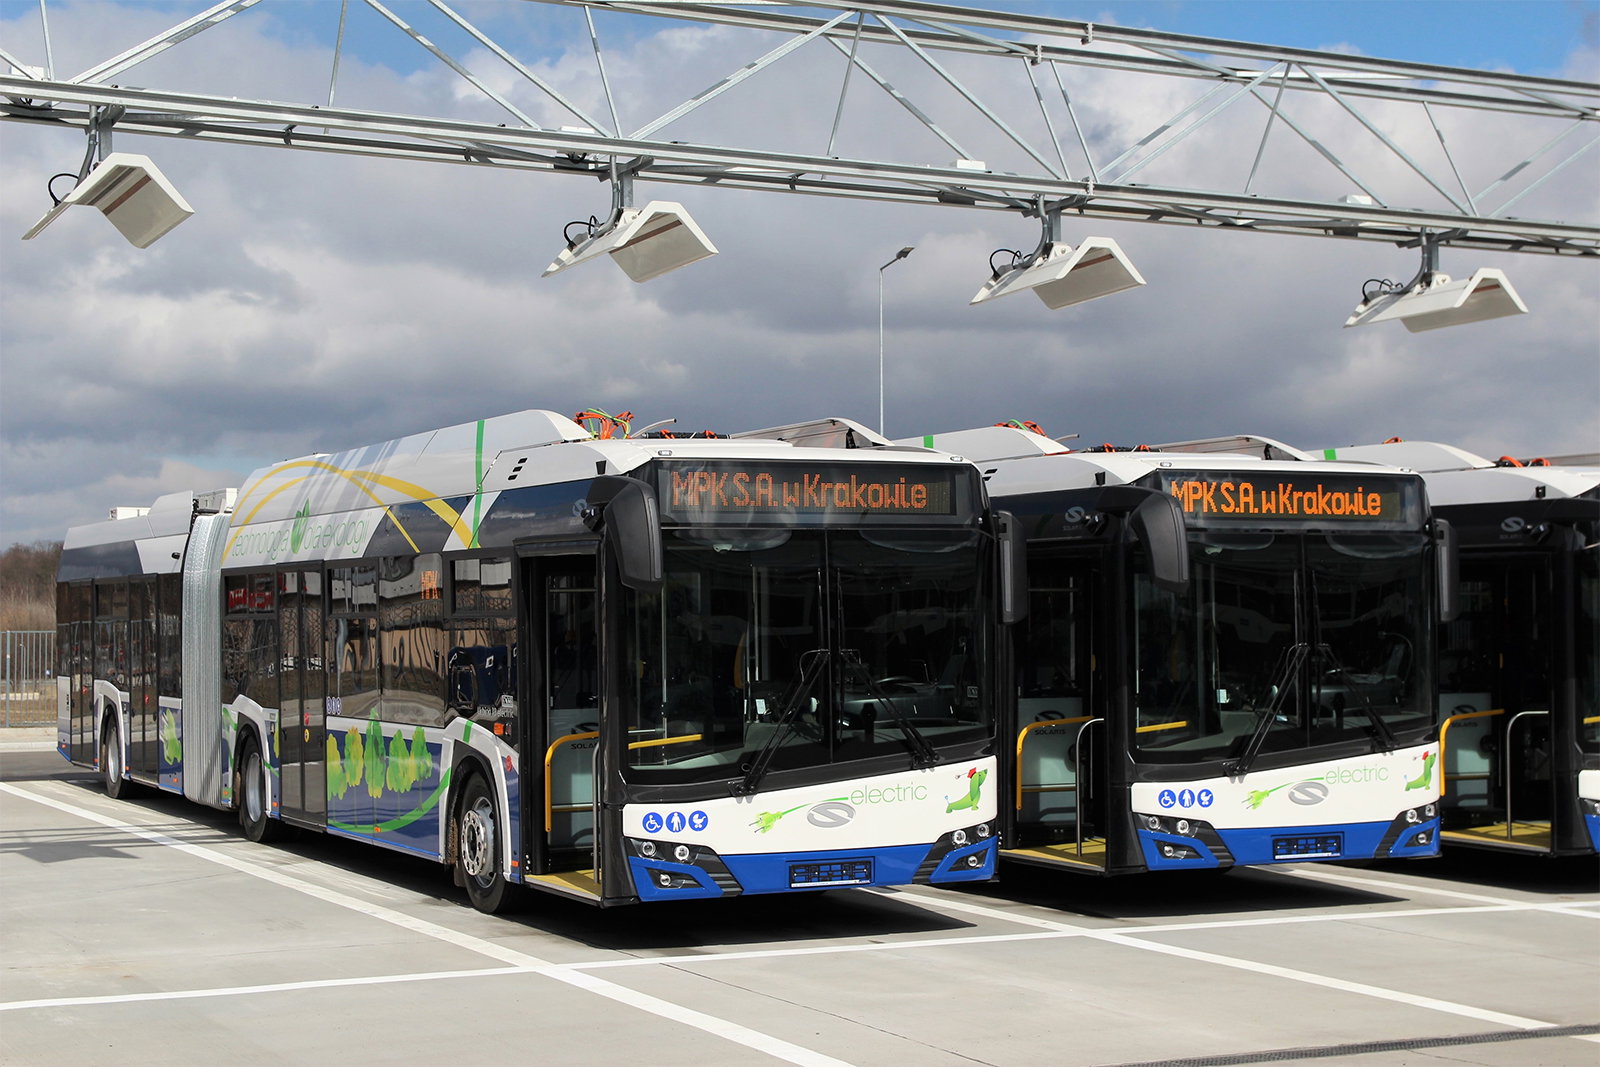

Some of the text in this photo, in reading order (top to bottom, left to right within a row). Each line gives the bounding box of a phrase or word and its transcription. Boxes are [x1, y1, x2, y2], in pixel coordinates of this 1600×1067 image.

[672, 471, 728, 506] MPK
[733, 472, 778, 507] S.A.
[803, 473, 928, 509] Krakowie
[1171, 481, 1218, 513] MPK
[1220, 482, 1259, 514] S.A.
[1278, 483, 1382, 516] Krakowie
[570, 742, 598, 750] SOLA
[1326, 763, 1389, 785] electric
[850, 781, 928, 805] electric
